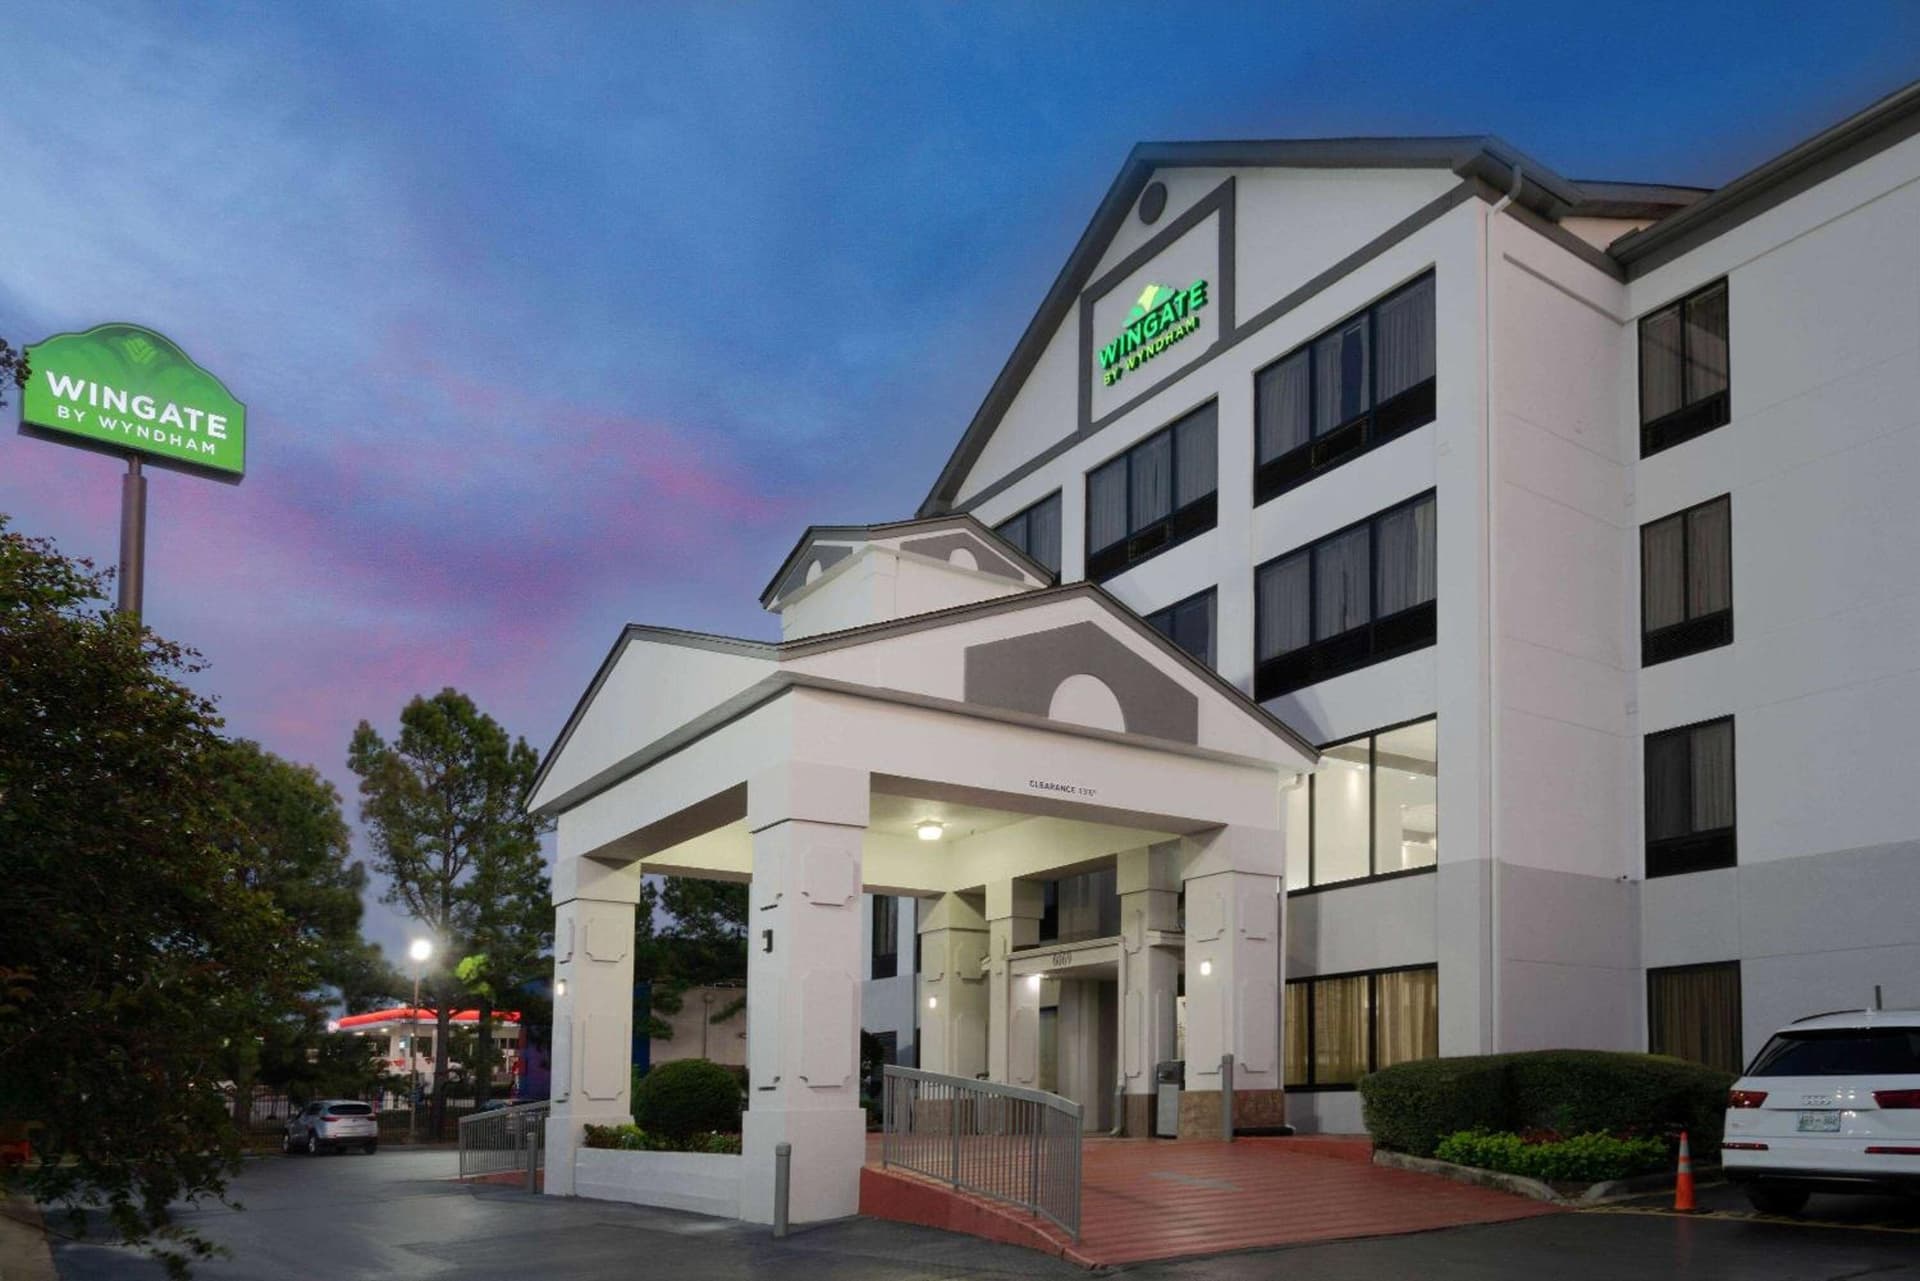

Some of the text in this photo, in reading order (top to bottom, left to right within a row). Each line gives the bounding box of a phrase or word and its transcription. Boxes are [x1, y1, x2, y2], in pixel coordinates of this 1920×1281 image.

[1099, 279, 1208, 369] WINGATE
[1103, 316, 1200, 386] BY WYNDHAM
[46, 370, 228, 440] WINGATE
[57, 405, 216, 455] BY WYNDHAM
[1029, 780, 1076, 794] CLEARANCE
